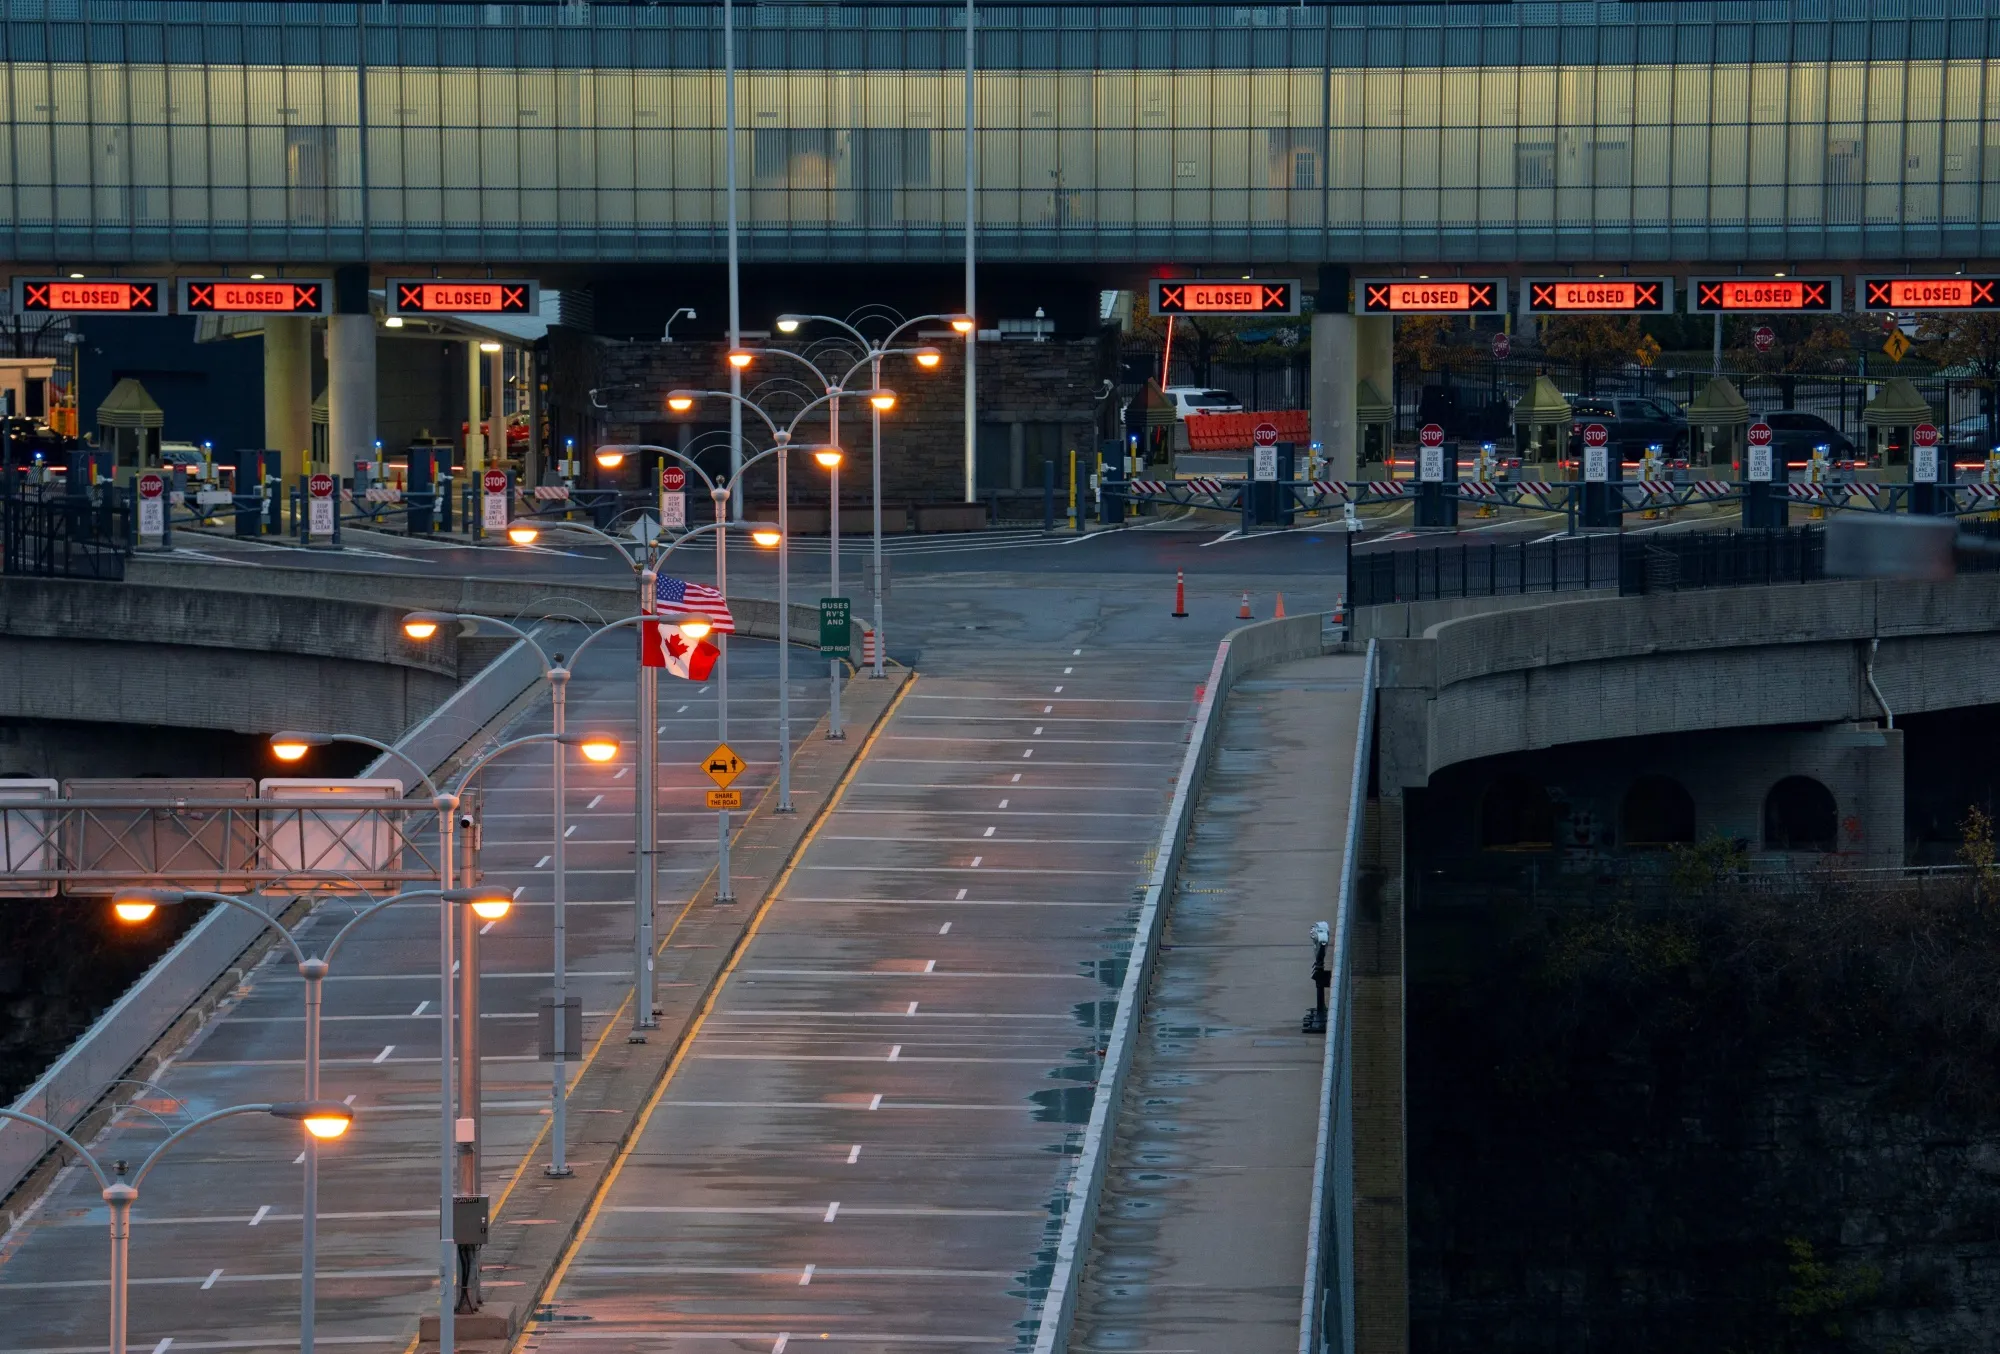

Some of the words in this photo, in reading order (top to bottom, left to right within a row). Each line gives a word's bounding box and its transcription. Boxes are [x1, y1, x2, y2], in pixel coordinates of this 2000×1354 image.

[62, 291, 119, 303] CLOSED
[226, 291, 284, 304] CLOSED
[435, 292, 492, 304] CLOSED
[1196, 292, 1252, 304] CLOSED
[1402, 292, 1458, 303] CLOSED
[1567, 290, 1624, 302] CLOSED
[1735, 290, 1792, 302] CLOSED
[1903, 288, 1961, 300] CLOSED
[1256, 431, 1276, 440] STOP
[1422, 431, 1442, 440] STOP
[1586, 431, 1606, 440] STOP
[1750, 431, 1770, 439] STOP
[1916, 431, 1936, 440] STOP
[485, 477, 505, 486] STOP
[664, 475, 683, 483] STOP
[141, 481, 161, 491] STOP
[311, 481, 332, 490] STOP
